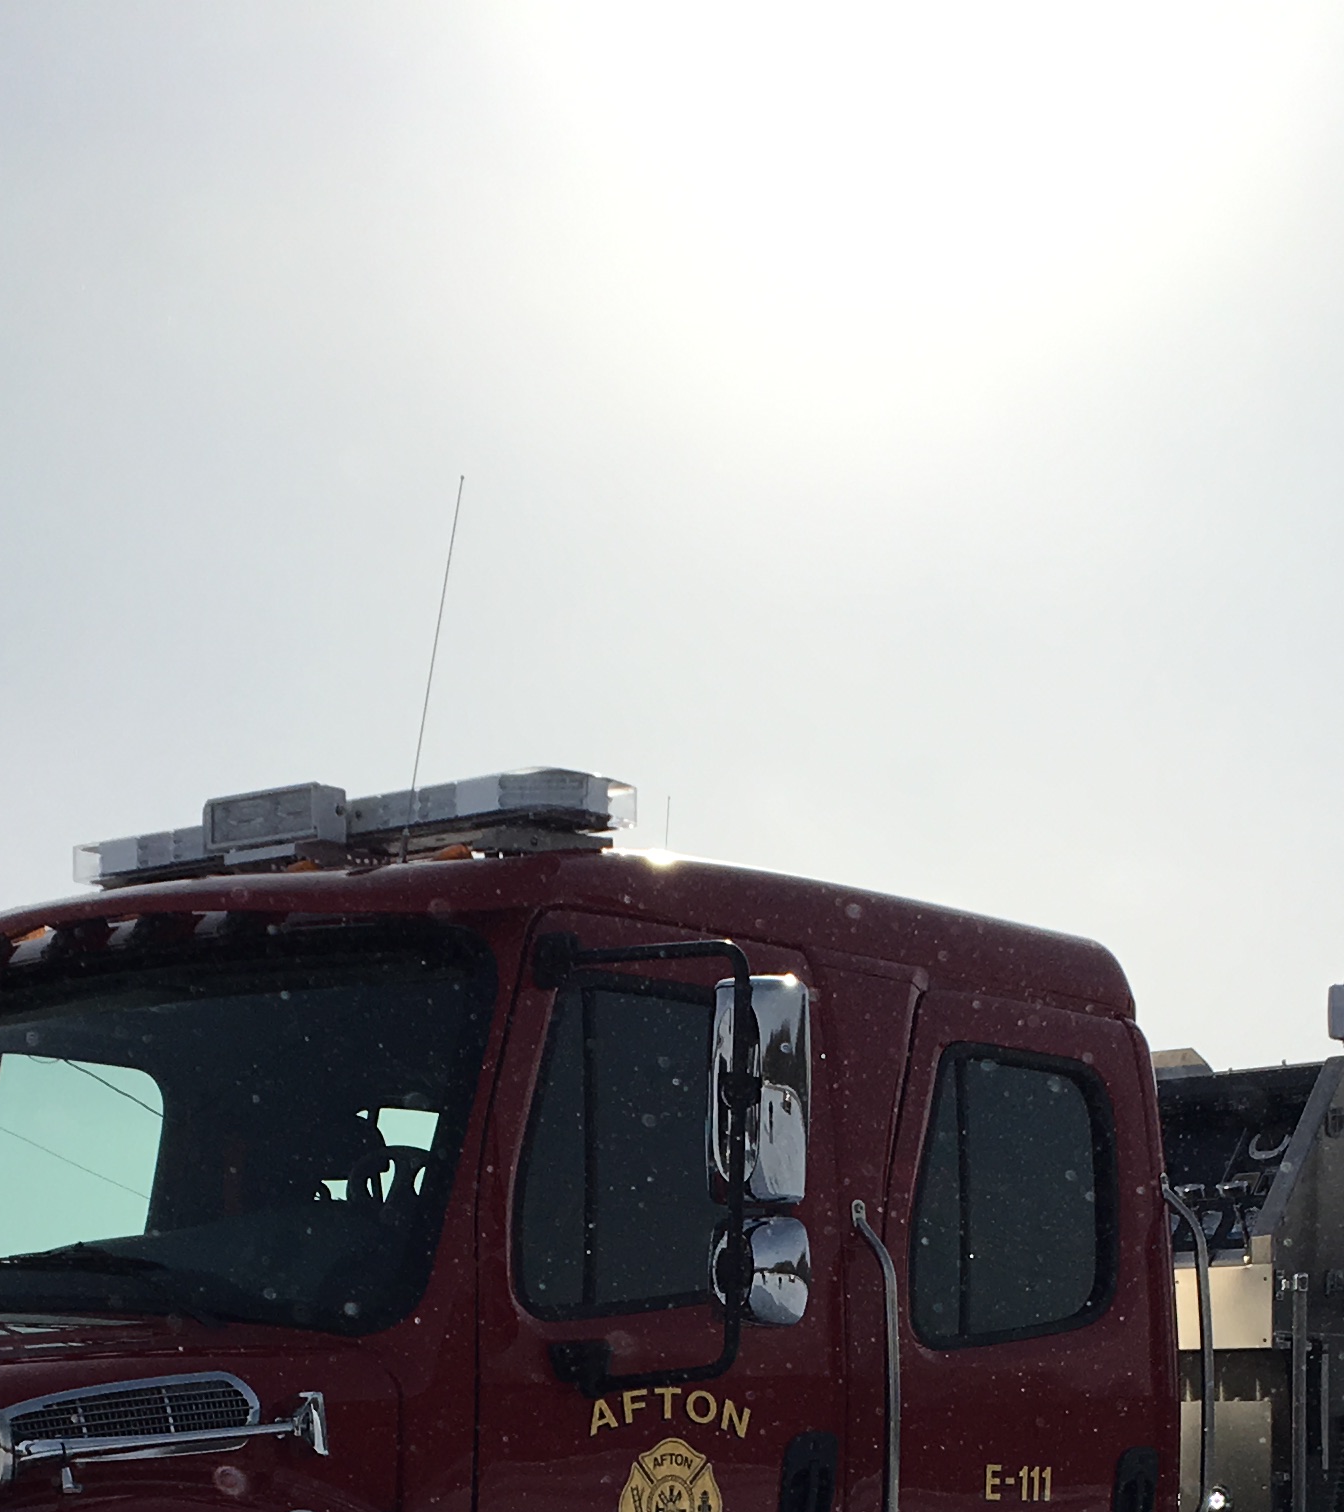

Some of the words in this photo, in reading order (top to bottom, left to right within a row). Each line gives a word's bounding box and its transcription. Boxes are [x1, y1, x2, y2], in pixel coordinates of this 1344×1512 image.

[590, 1387, 752, 1439] AFTON
[652, 1452, 694, 1470] AFTON
[985, 1464, 1052, 1502] E-111
